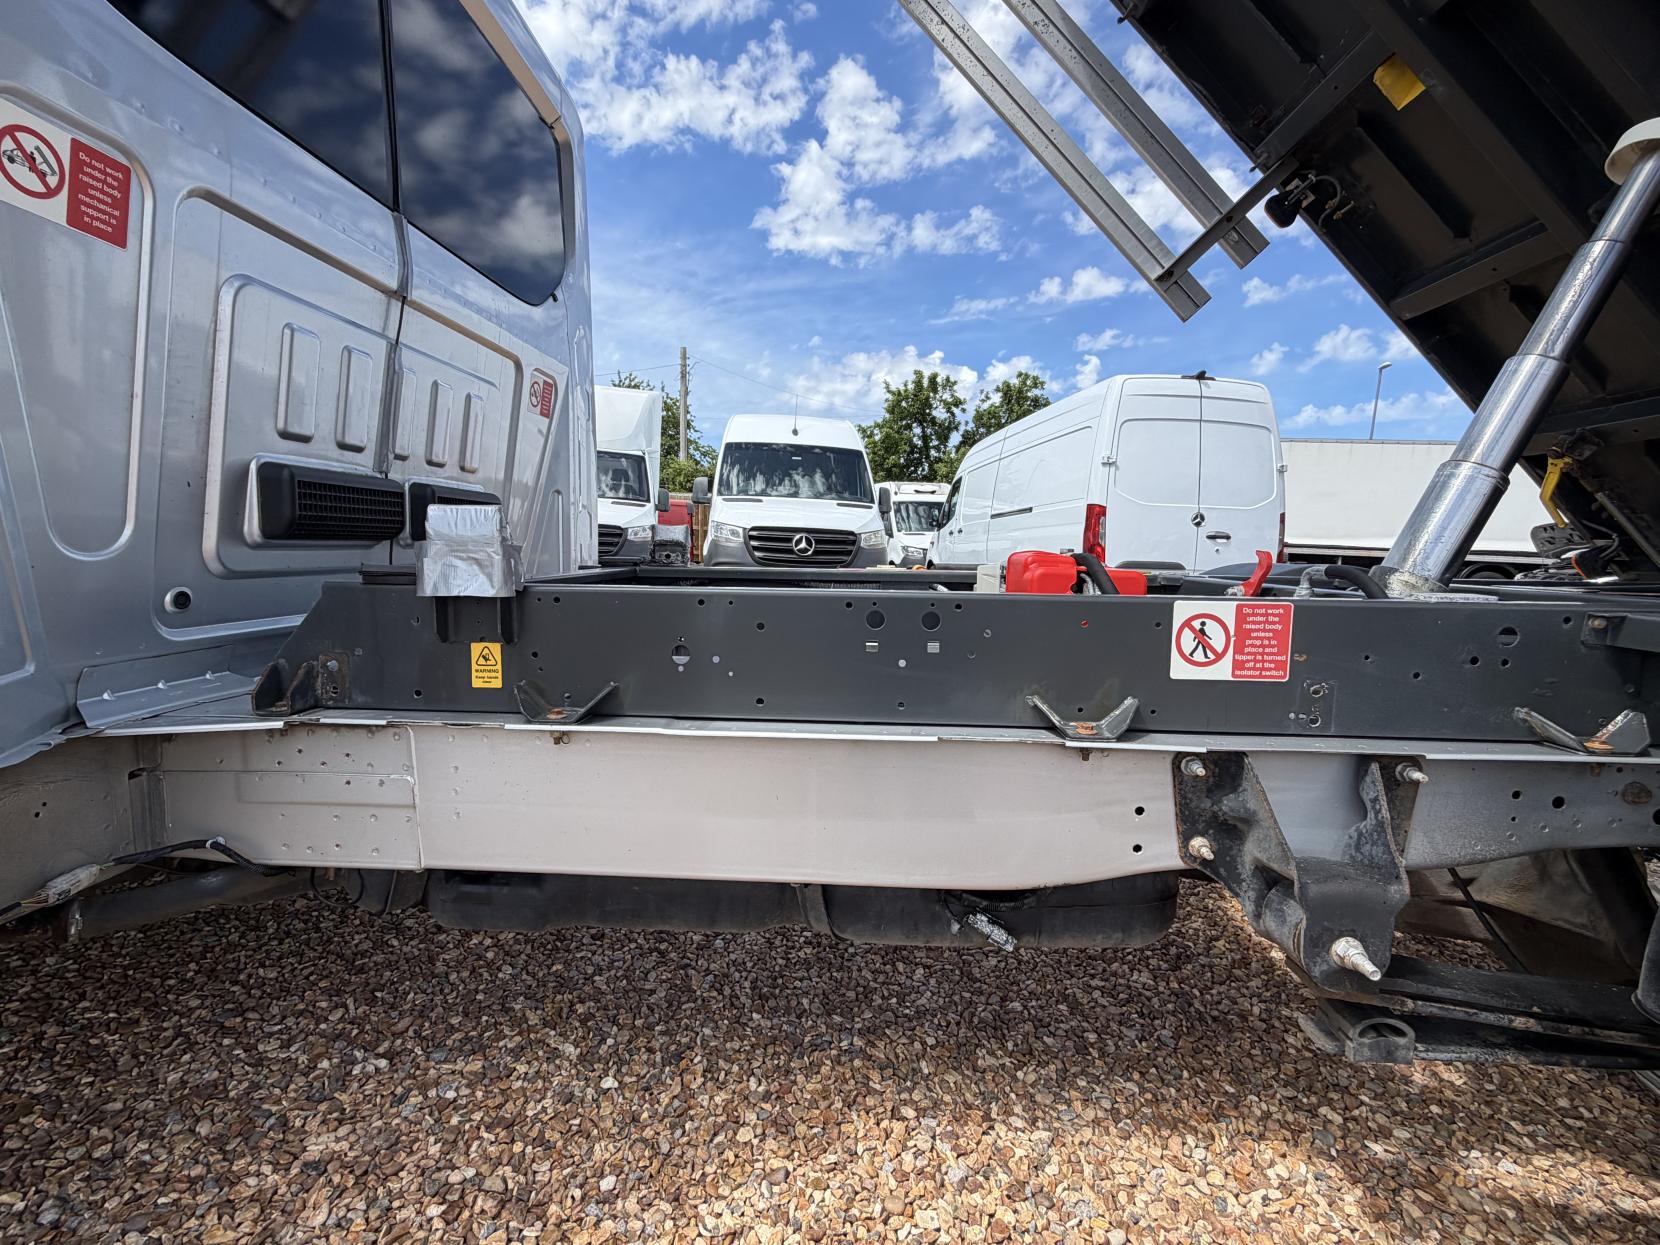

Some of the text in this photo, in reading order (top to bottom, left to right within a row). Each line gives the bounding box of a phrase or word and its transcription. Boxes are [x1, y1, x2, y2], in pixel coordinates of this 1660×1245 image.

[79, 152, 123, 180] Do not work
[83, 166, 118, 187] under the
[79, 174, 121, 199] raised body
[88, 188, 112, 203] unless
[78, 193, 120, 217] mechanical
[80, 204, 117, 225] support is
[84, 215, 112, 233] in place
